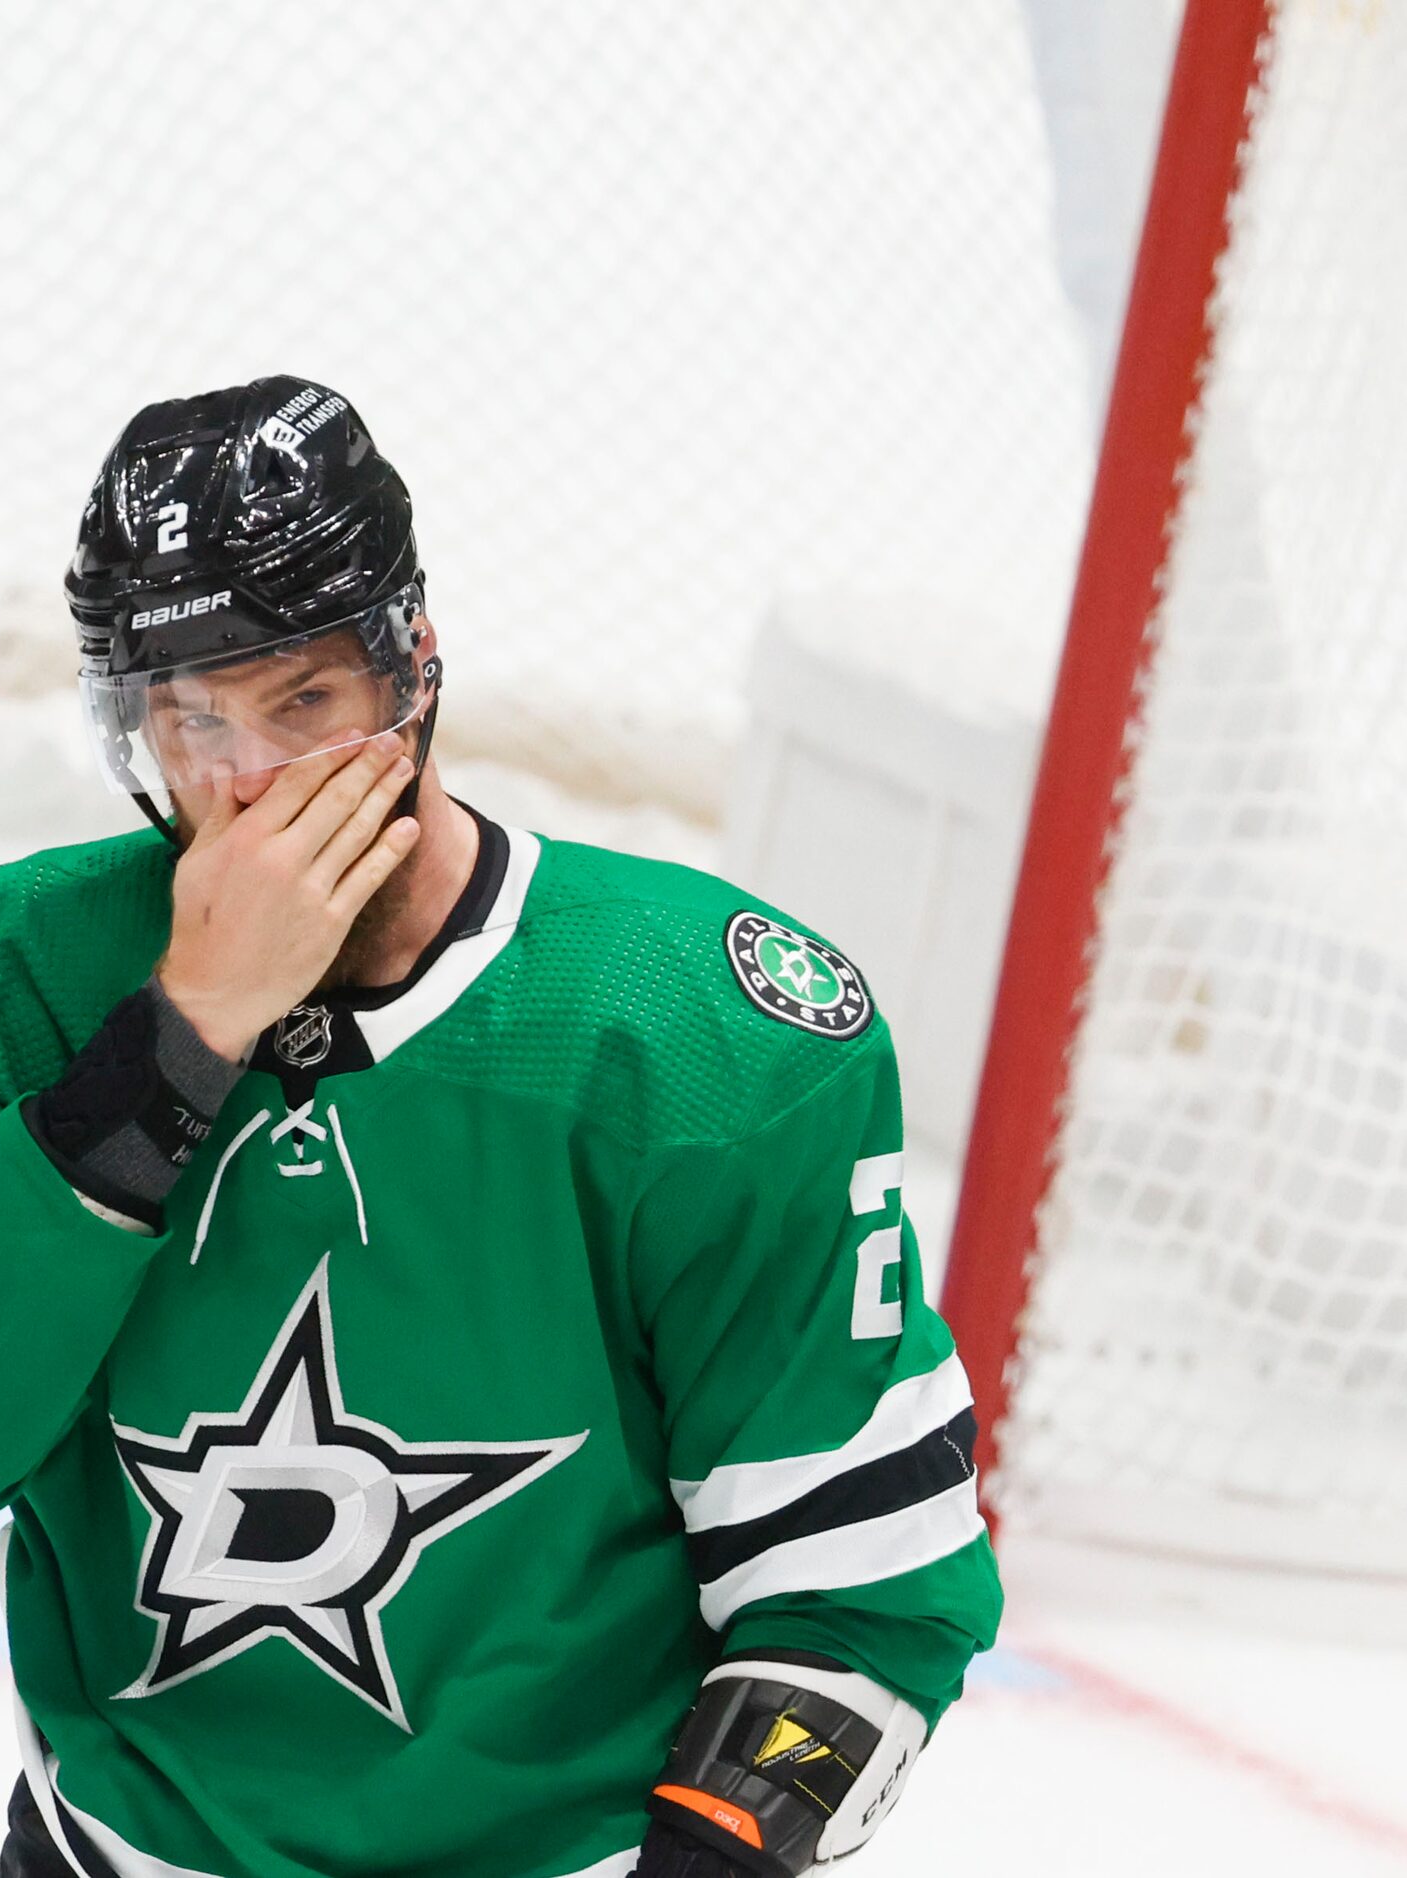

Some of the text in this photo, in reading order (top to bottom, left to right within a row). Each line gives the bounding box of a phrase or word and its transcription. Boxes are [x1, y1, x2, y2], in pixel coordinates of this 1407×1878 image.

[276, 387, 323, 423] ENERGY
[157, 502, 189, 554] 2
[131, 590, 232, 630] BAUER
[799, 967, 862, 1026] STARS
[288, 1020, 320, 1054] NHL
[860, 1748, 908, 1828] CCM
